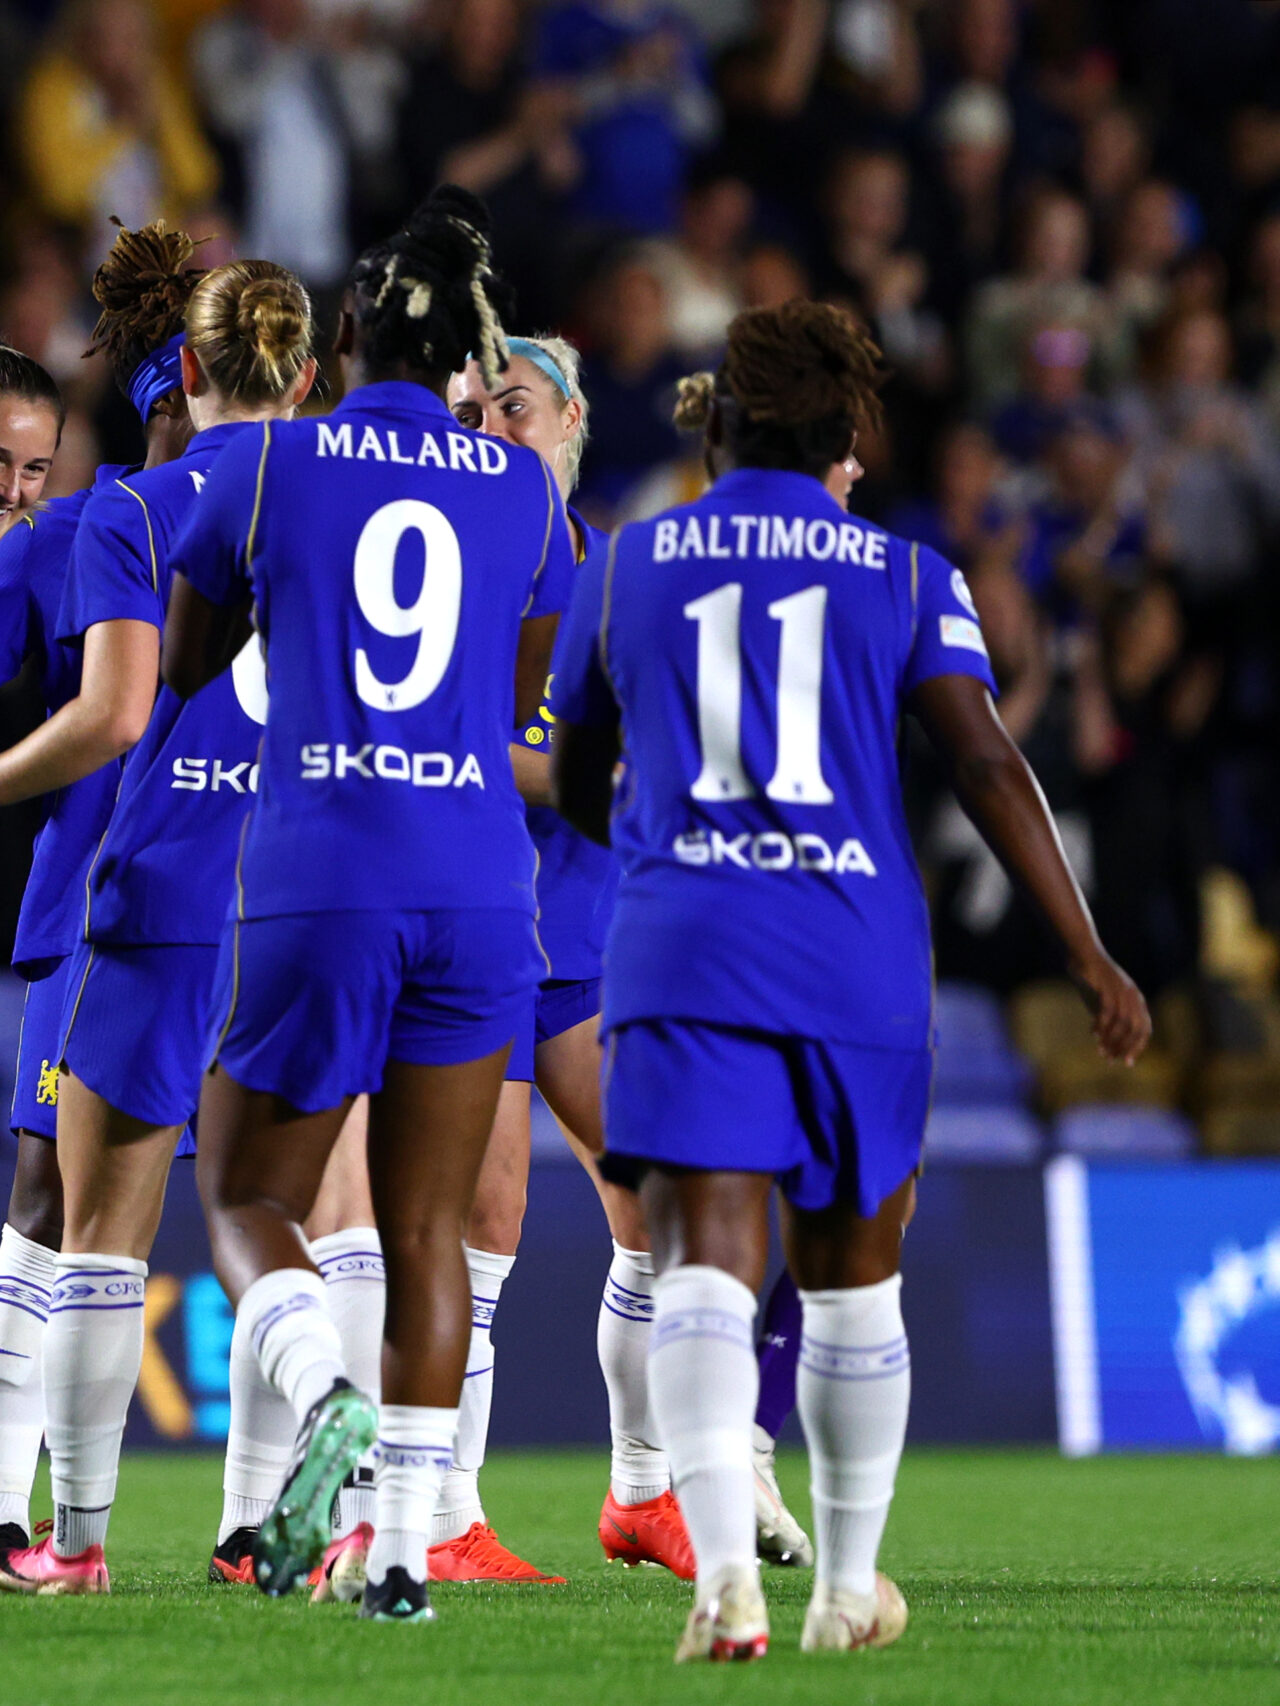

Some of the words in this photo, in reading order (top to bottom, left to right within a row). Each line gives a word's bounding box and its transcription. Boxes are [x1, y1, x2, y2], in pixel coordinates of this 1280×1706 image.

[317, 422, 508, 476] MALARD
[353, 498, 463, 712] 9
[652, 514, 889, 570] BALTIMORE
[684, 582, 834, 805] 11
